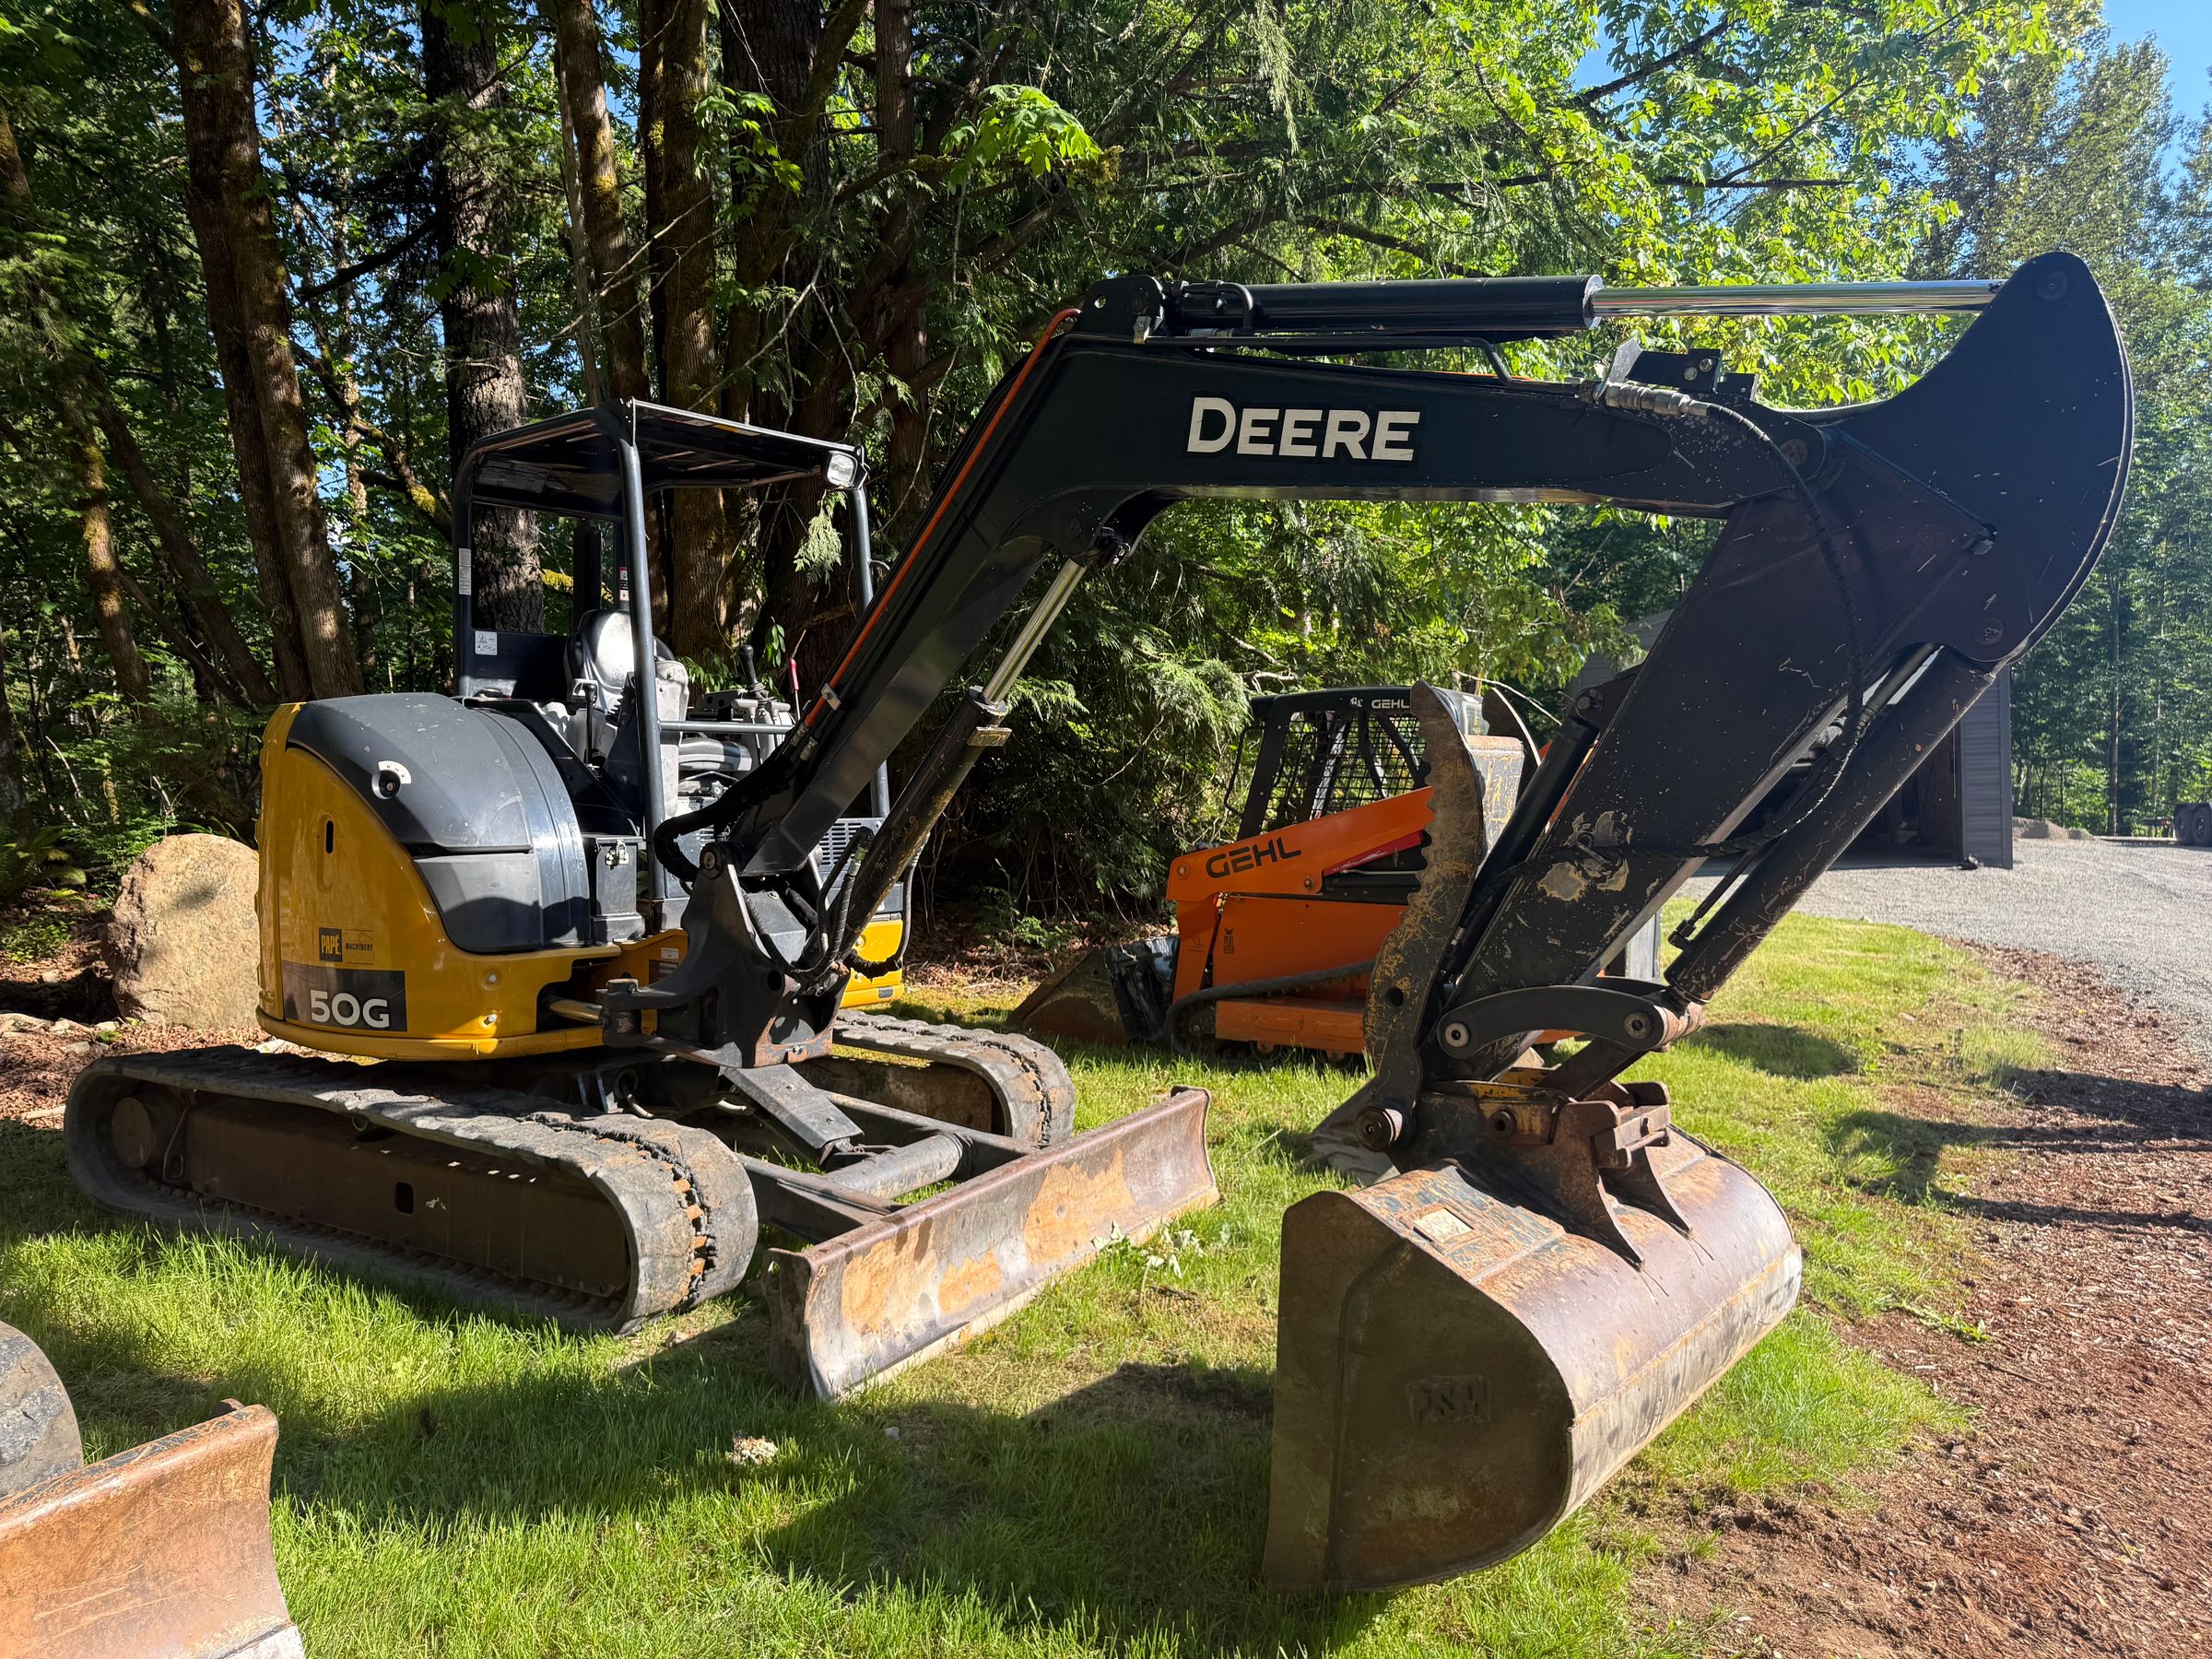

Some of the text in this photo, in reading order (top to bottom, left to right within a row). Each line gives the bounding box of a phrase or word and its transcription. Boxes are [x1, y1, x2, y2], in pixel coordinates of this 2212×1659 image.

[1187, 397, 1421, 461] DEERE
[1371, 699, 1410, 709] GEHL
[1206, 837, 1302, 878] GEHL
[345, 943, 373, 951] MACHINERY
[310, 990, 390, 1029] 50G
